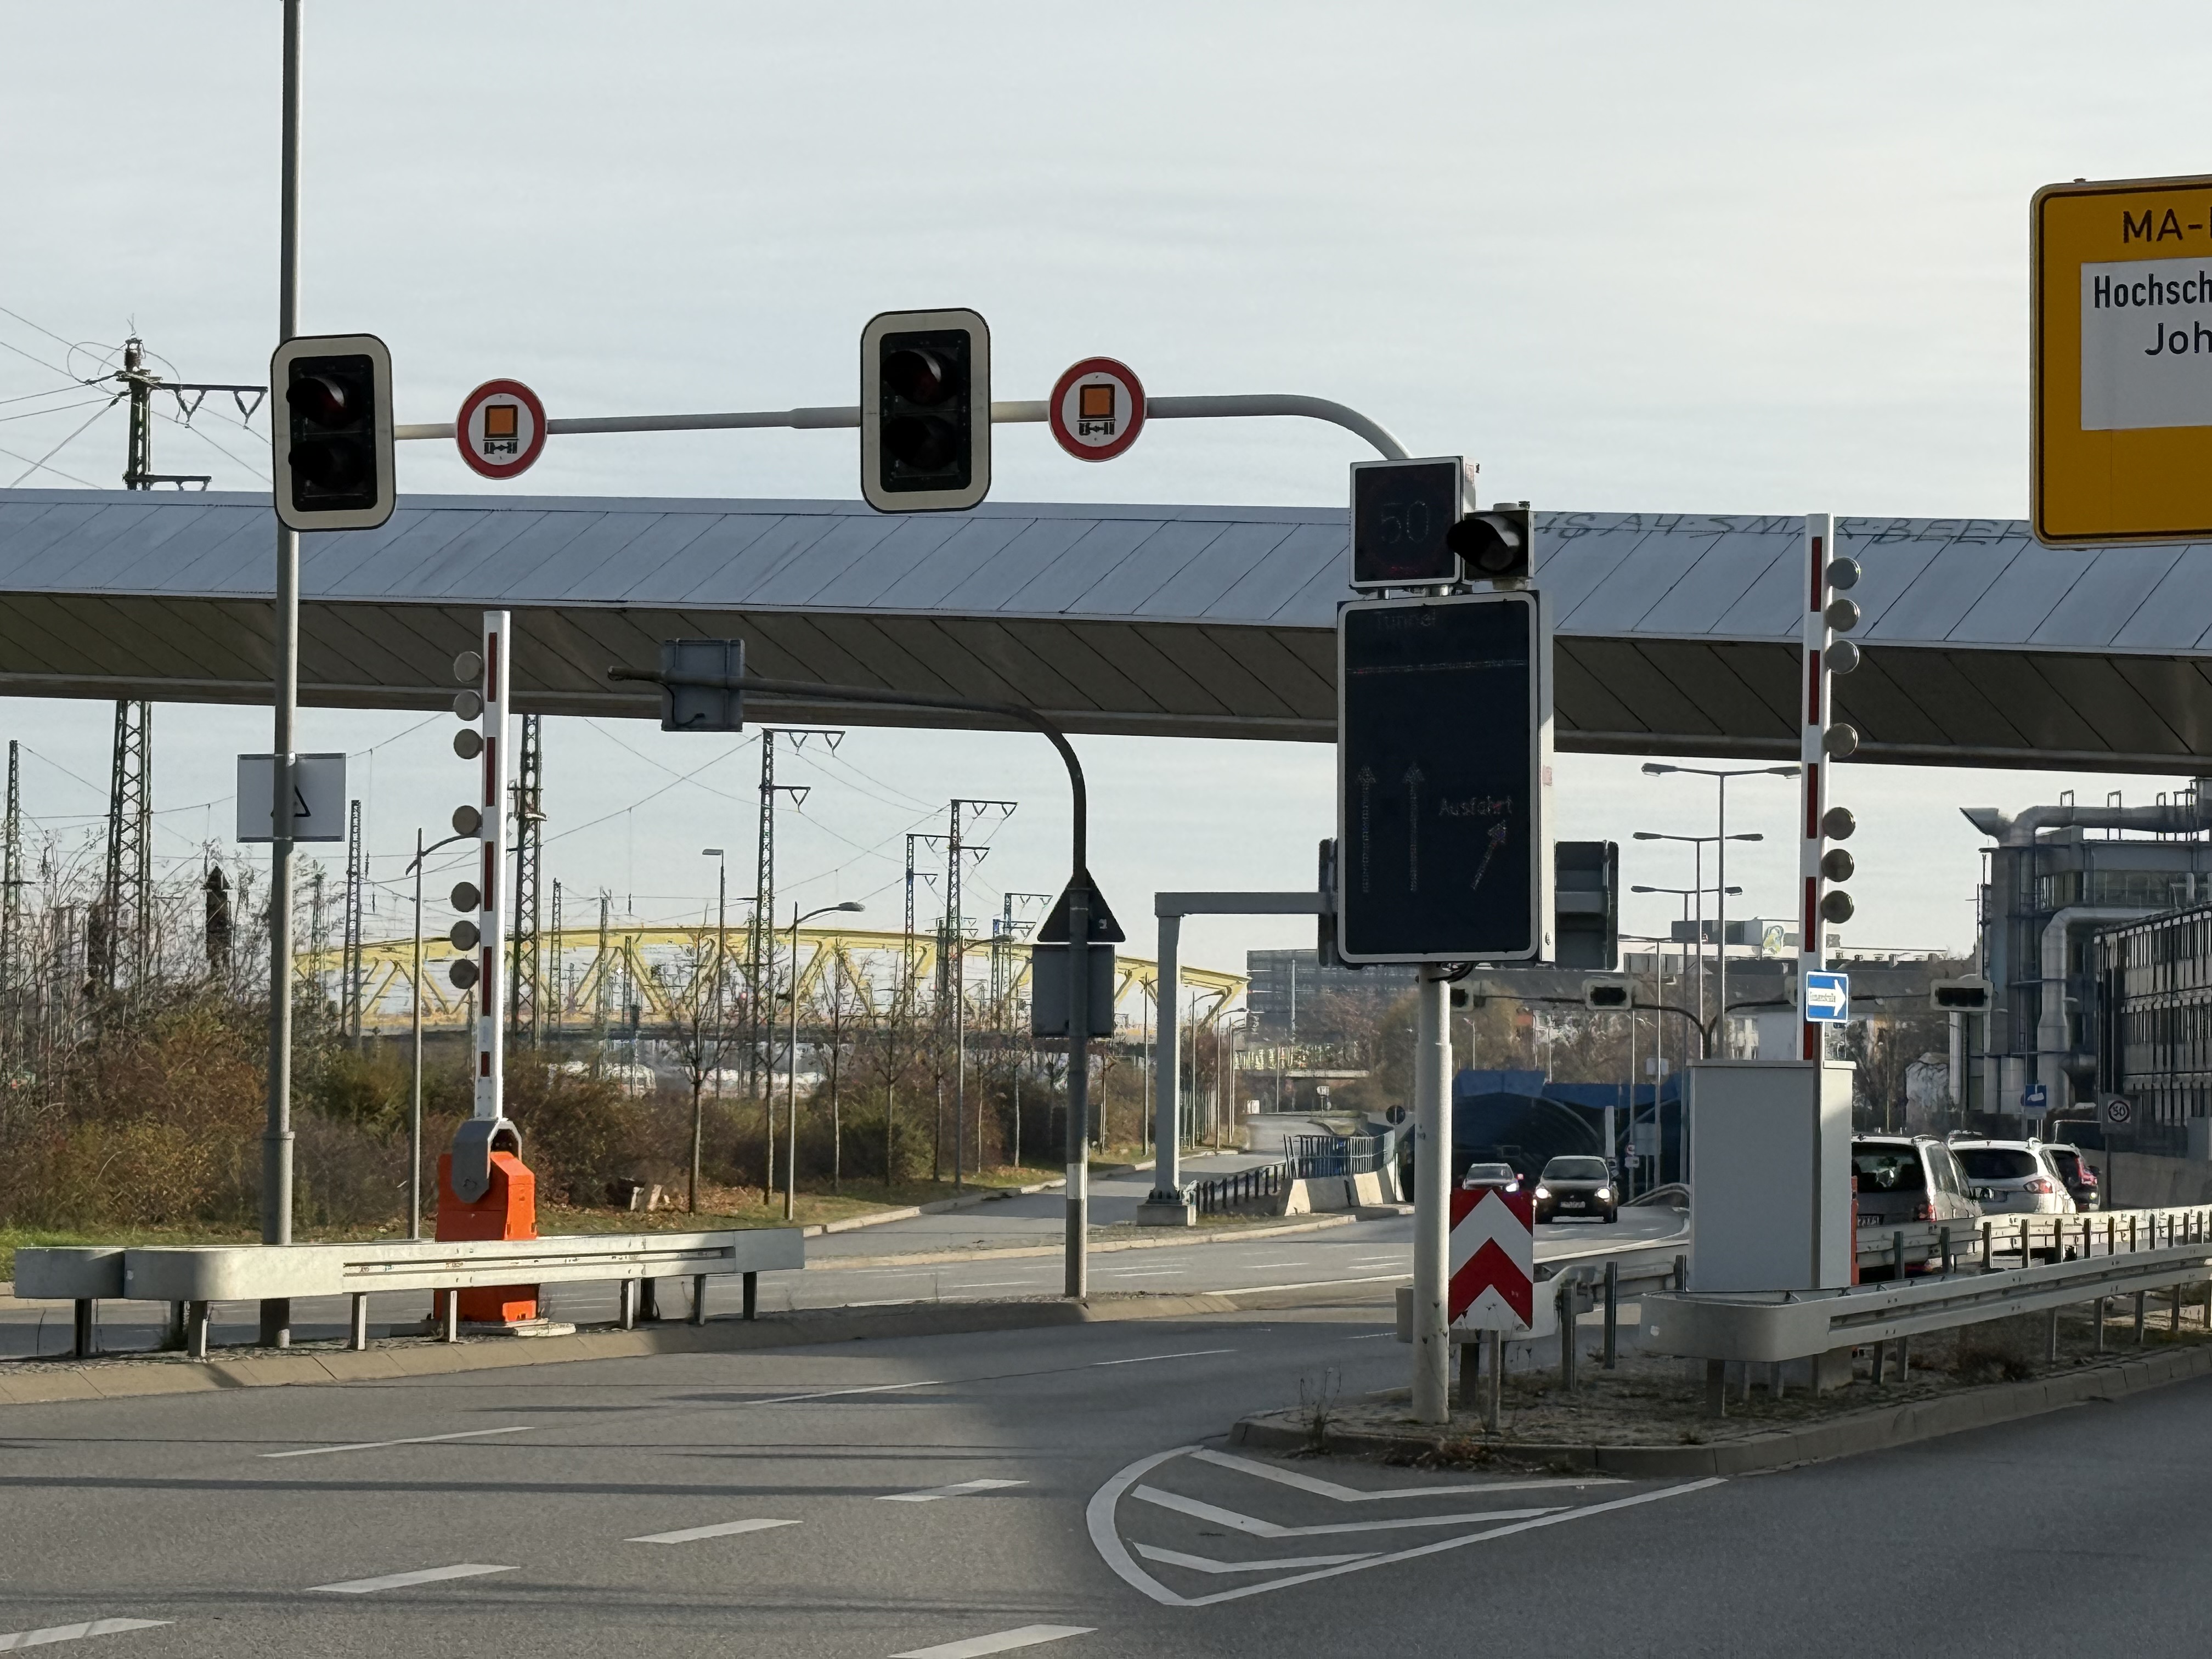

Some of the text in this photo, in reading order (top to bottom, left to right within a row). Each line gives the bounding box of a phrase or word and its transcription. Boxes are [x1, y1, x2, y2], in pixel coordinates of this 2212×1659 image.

[2123, 206, 2212, 243] MA-
[2095, 270, 2212, 308] Hochsch
[1380, 500, 1429, 544] 50
[1438, 794, 1513, 817] Ausfahrt
